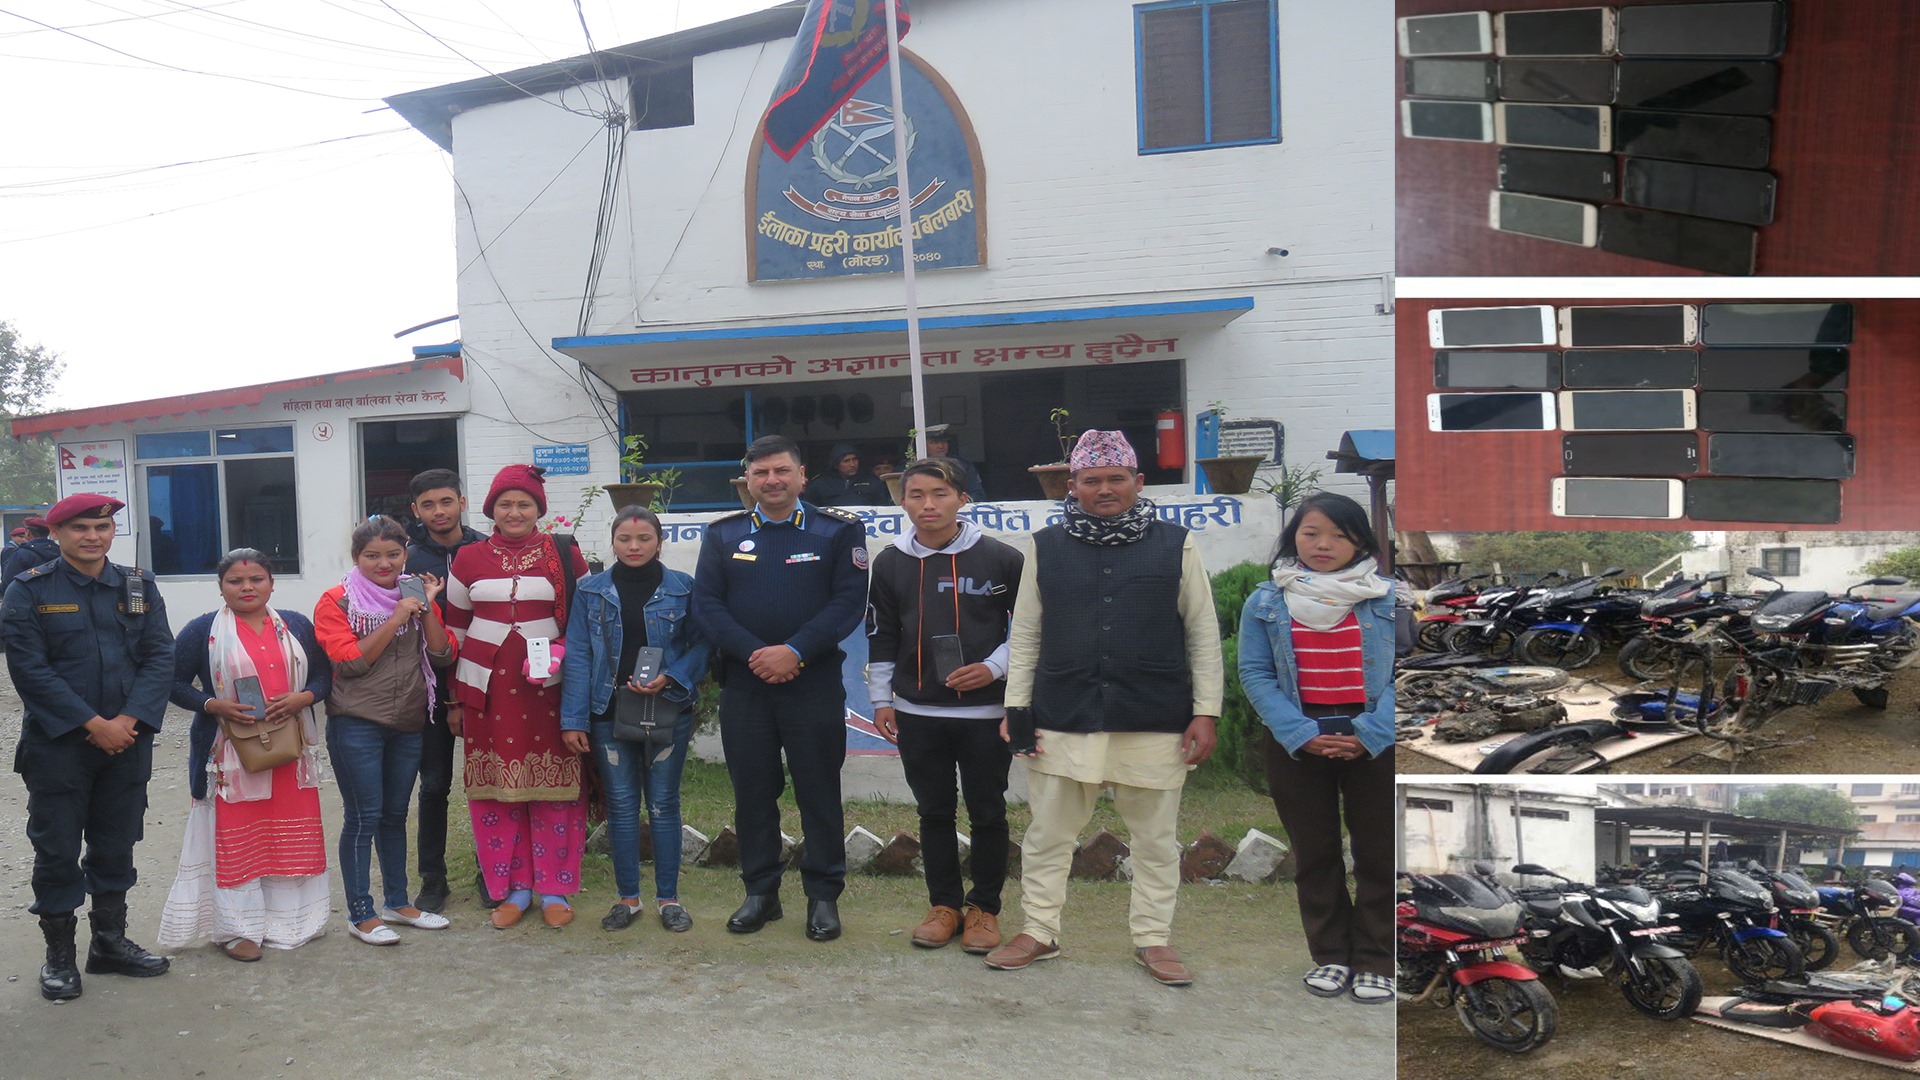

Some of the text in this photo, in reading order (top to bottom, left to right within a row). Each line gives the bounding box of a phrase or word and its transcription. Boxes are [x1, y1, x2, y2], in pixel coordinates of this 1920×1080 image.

[808, 229, 850, 257] प्रहरी
[314, 398, 333, 410] तथा
[334, 397, 354, 410] बाल
[355, 393, 391, 408] बालिका
[394, 391, 418, 406] सेवा
[421, 389, 449, 405] केन्द्र
[937, 576, 993, 597] FILA
